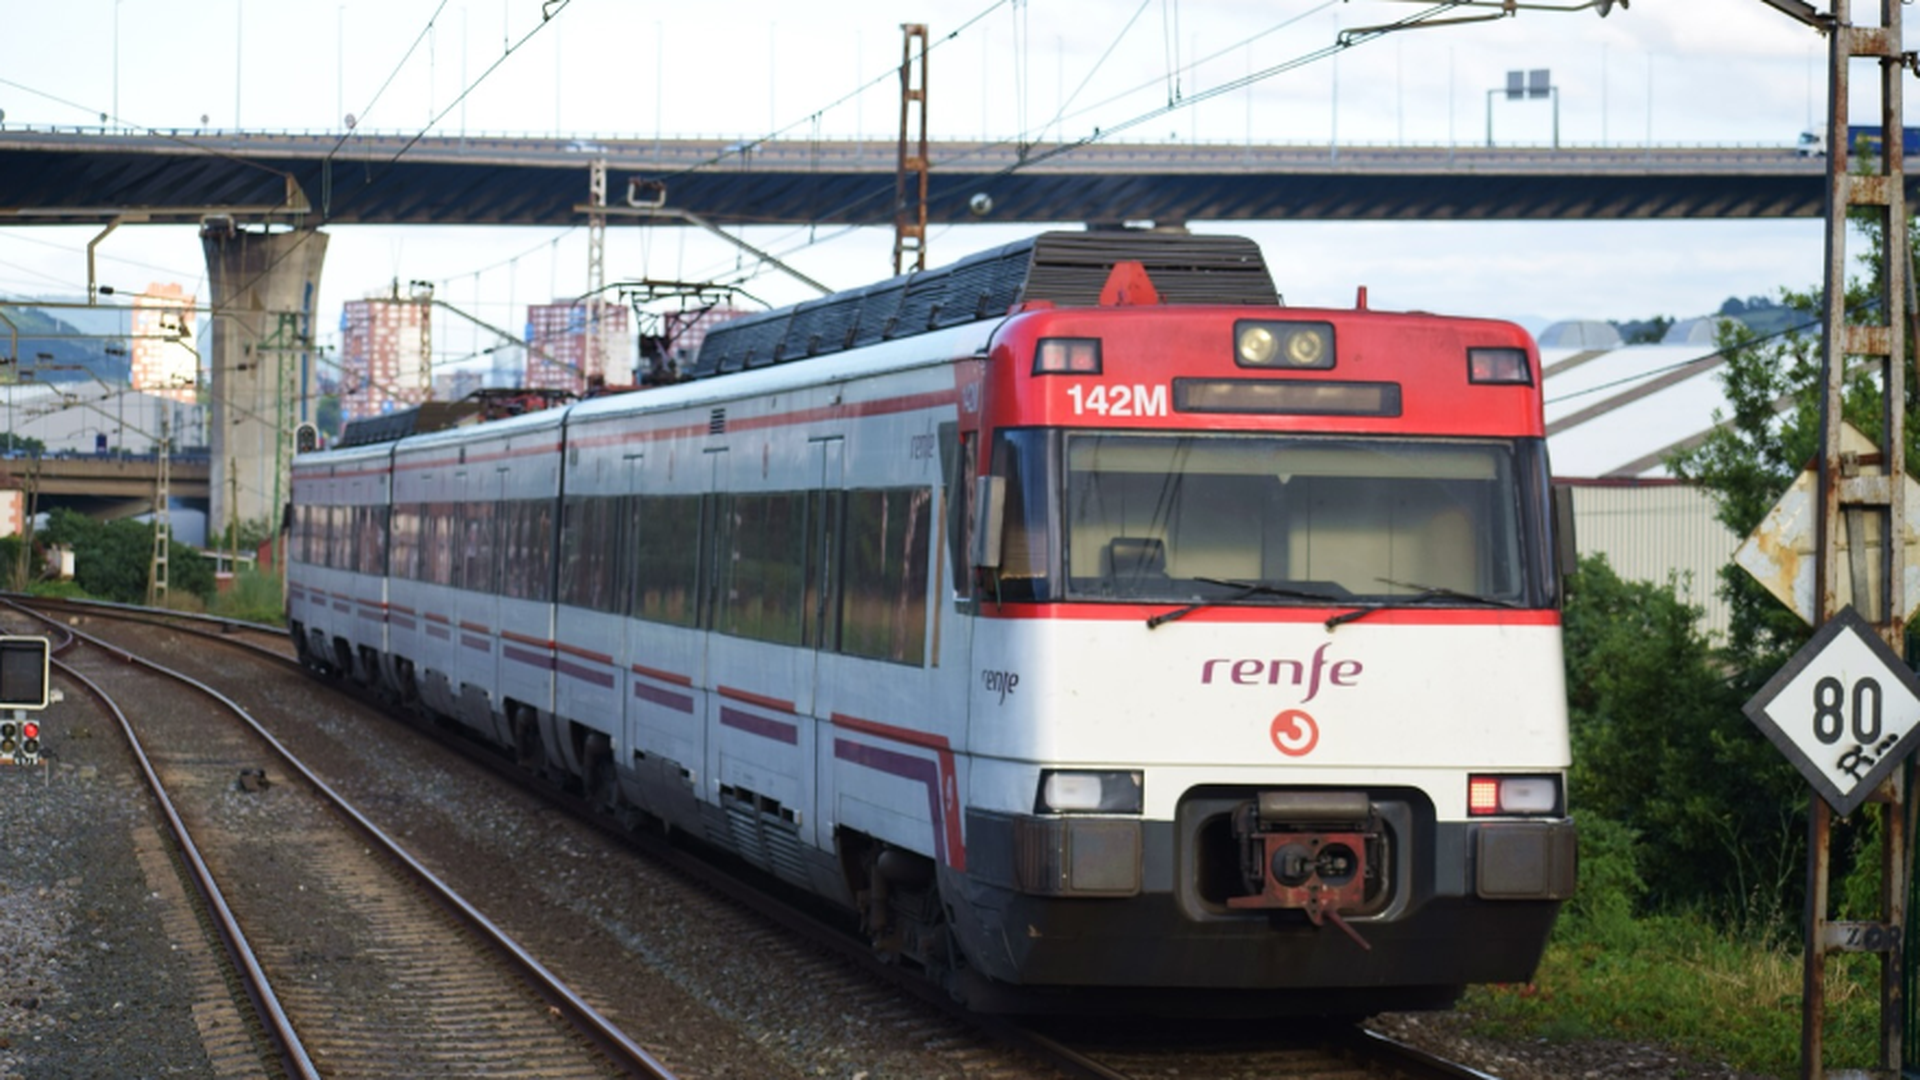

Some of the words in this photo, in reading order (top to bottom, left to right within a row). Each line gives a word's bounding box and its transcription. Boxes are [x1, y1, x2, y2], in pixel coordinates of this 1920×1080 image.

[1067, 384, 1167, 416] 142M
[981, 669, 1019, 706] renfe
[1201, 642, 1364, 704] renfe
[1813, 676, 1883, 745] 80
